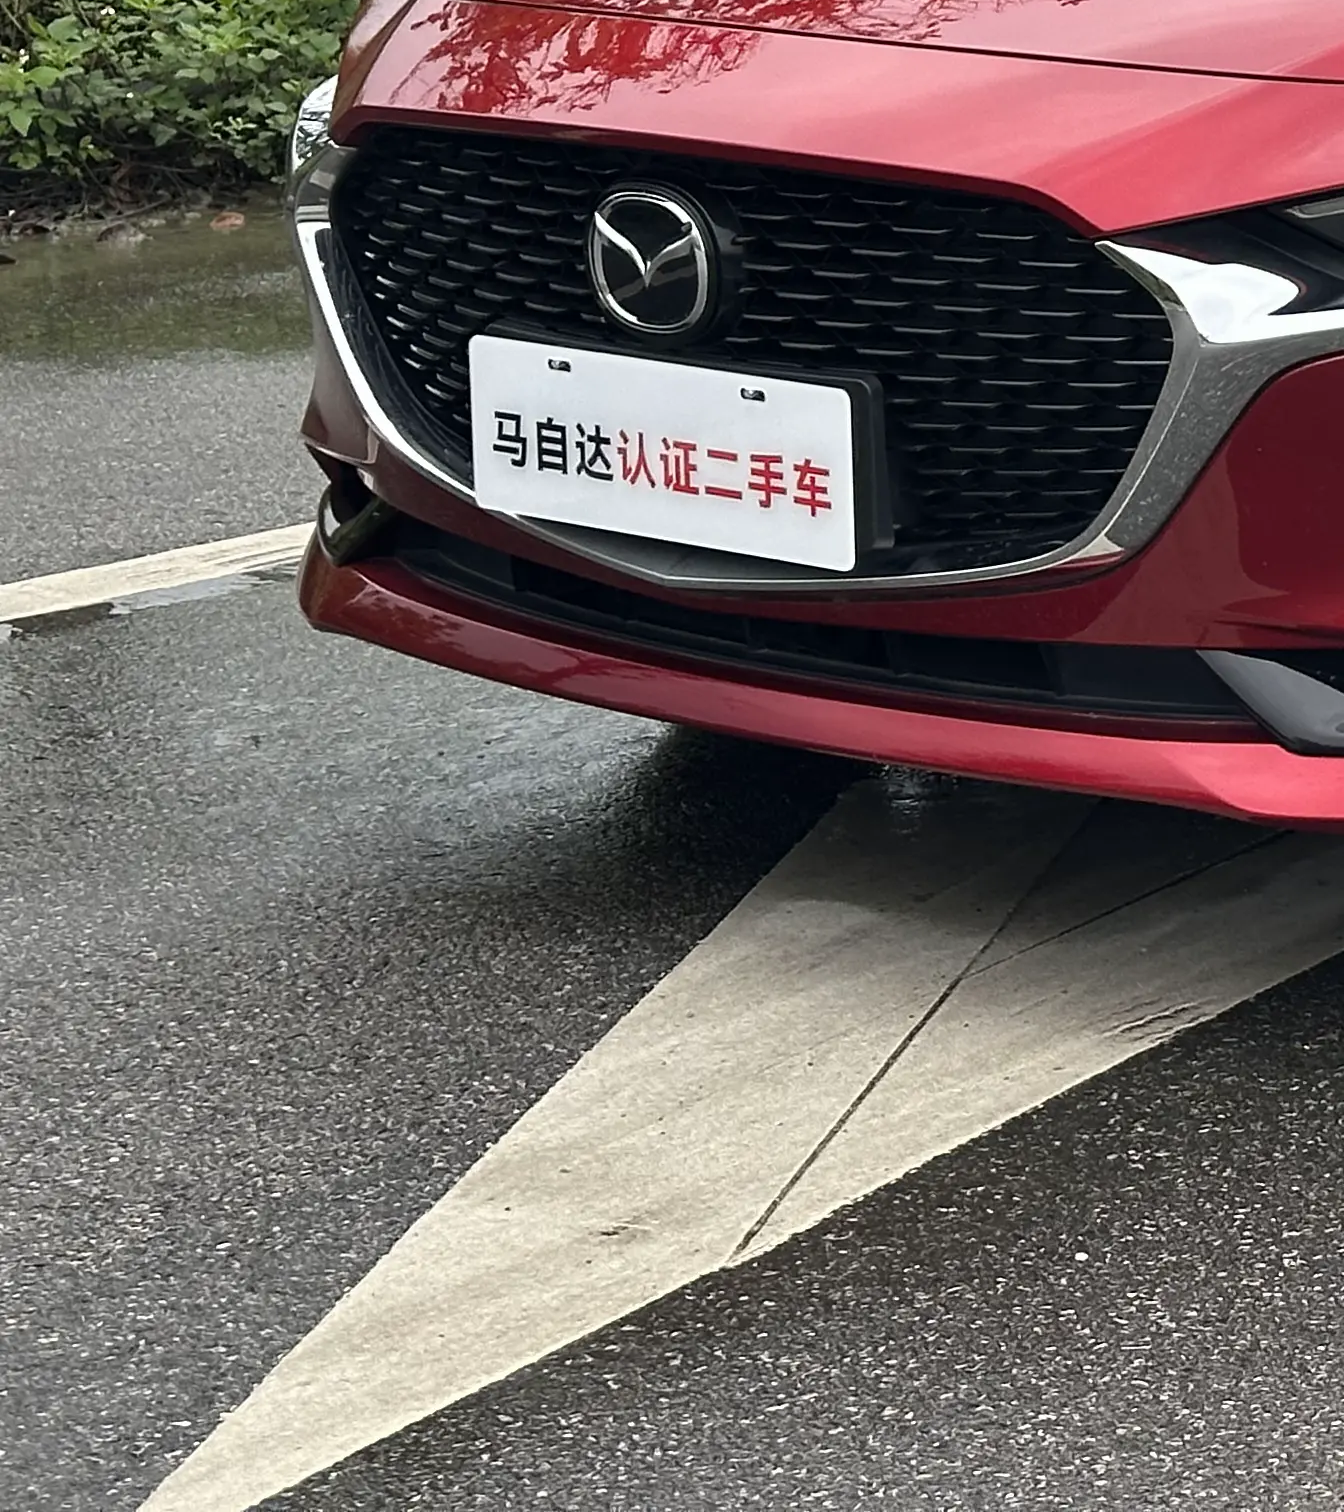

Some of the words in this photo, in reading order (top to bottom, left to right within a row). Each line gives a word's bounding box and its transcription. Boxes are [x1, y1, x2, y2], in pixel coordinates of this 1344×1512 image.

[492, 410, 833, 517] 马自达认证二手车
